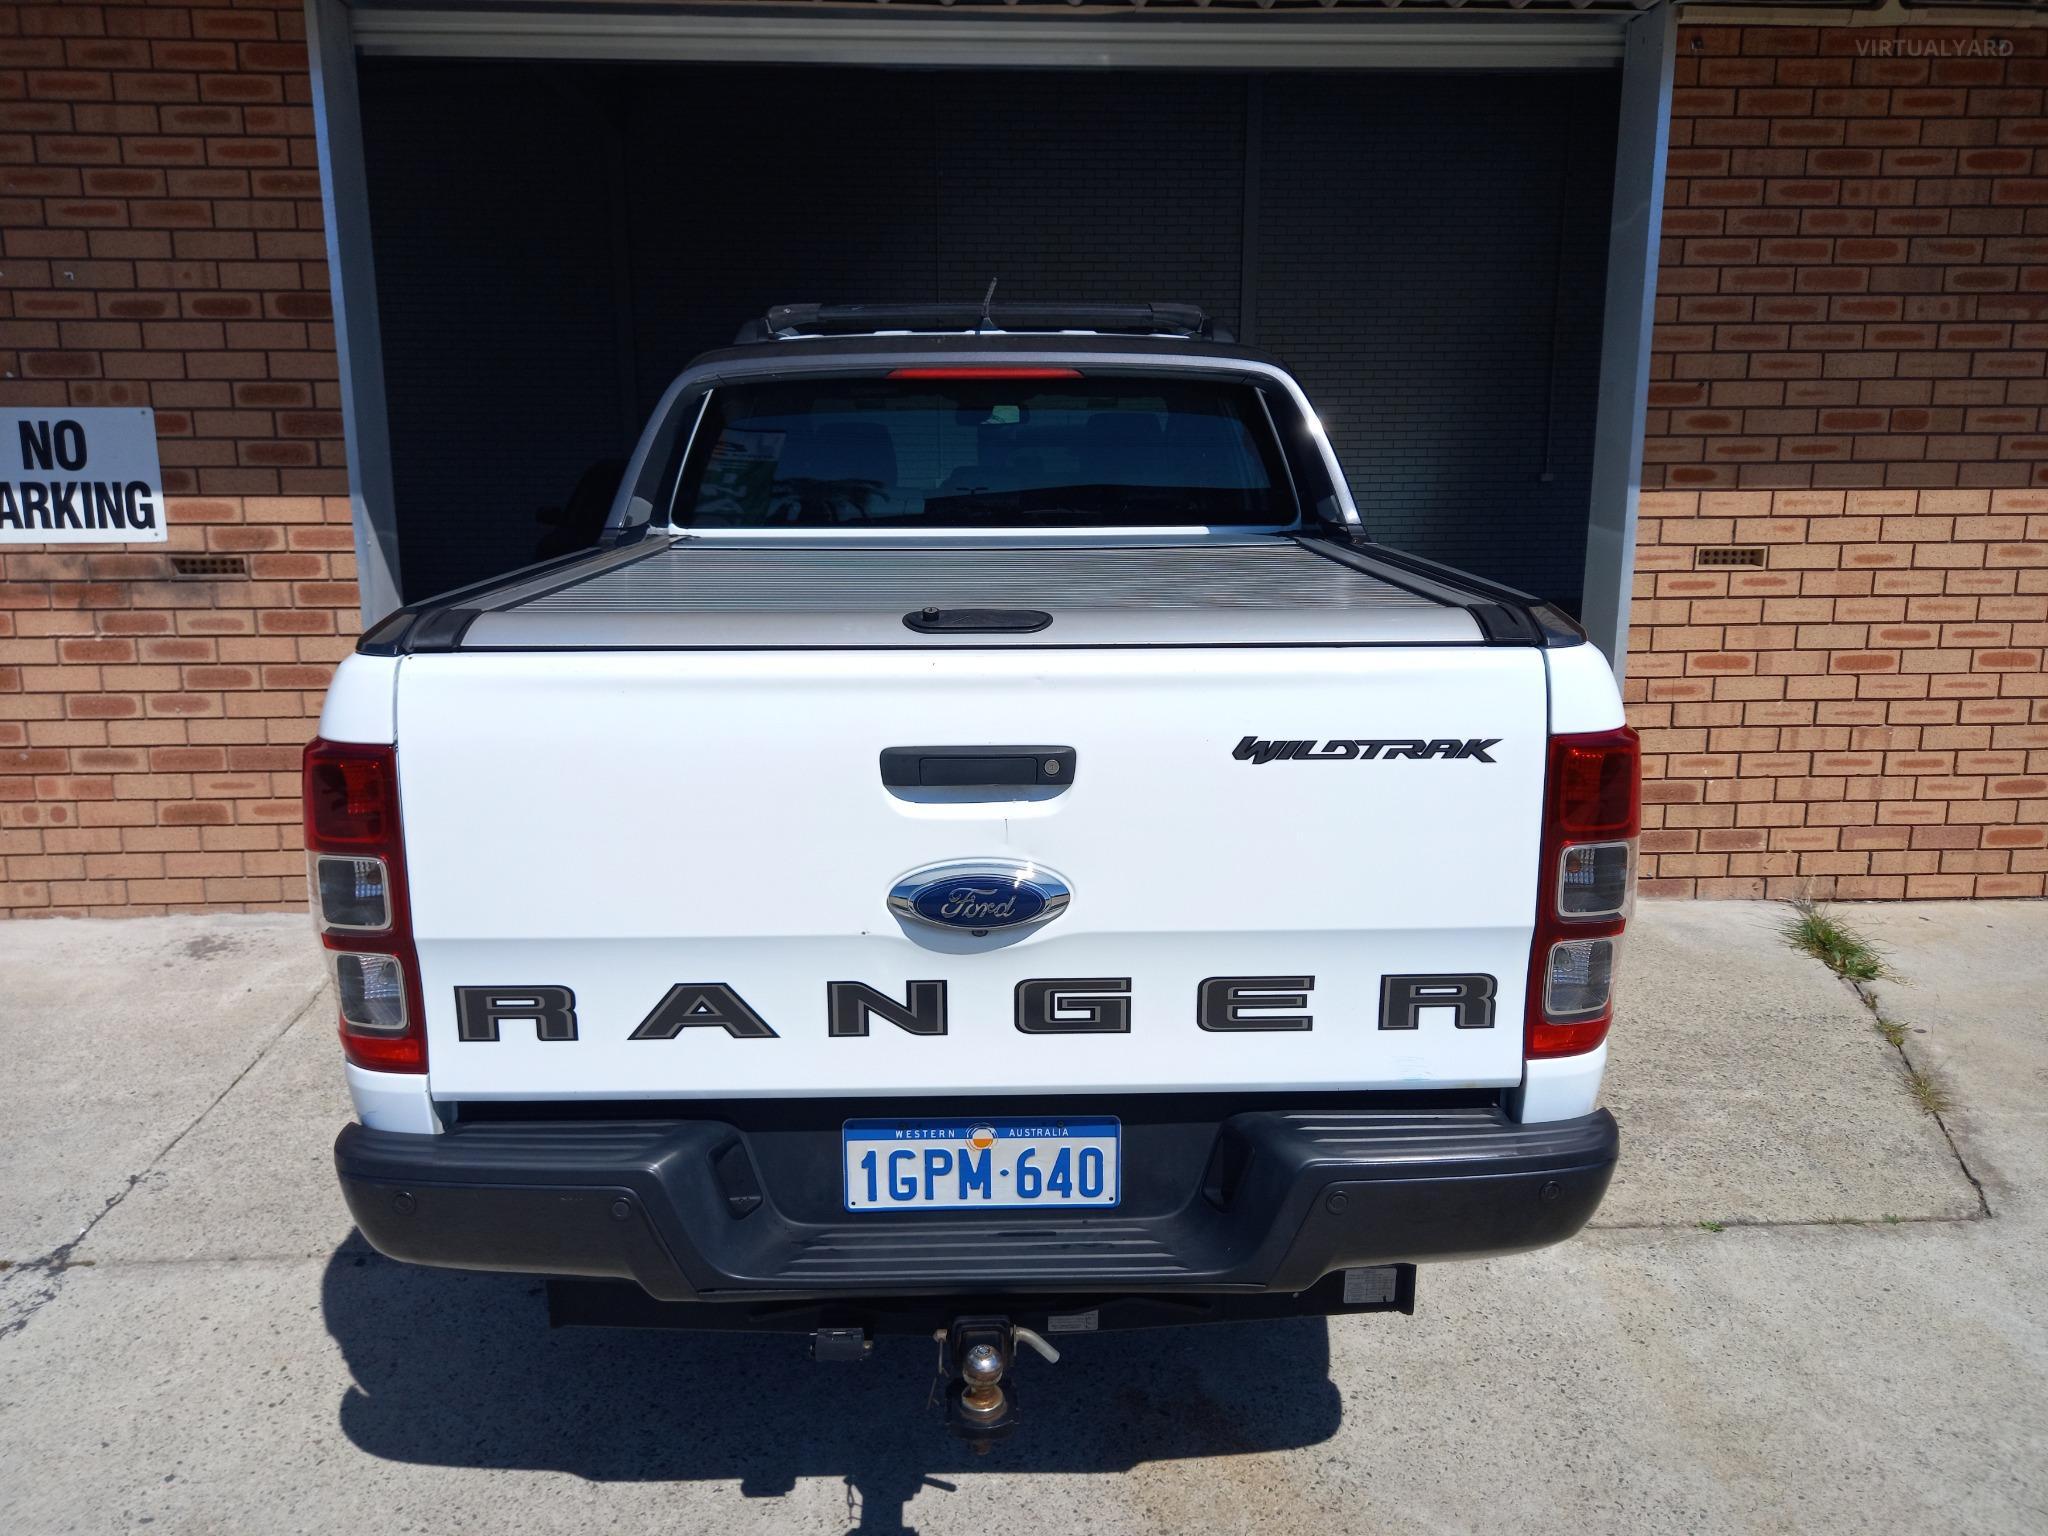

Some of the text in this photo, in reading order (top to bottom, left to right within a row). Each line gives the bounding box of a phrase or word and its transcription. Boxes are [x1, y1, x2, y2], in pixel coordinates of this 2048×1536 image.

[18, 419, 88, 471] NO
[1231, 736, 1503, 764] WILDTRAK
[941, 887, 1017, 919] Ford
[453, 973, 1498, 1043] RANGER
[894, 1127, 1069, 1139] WESTERN AUSTRALIA
